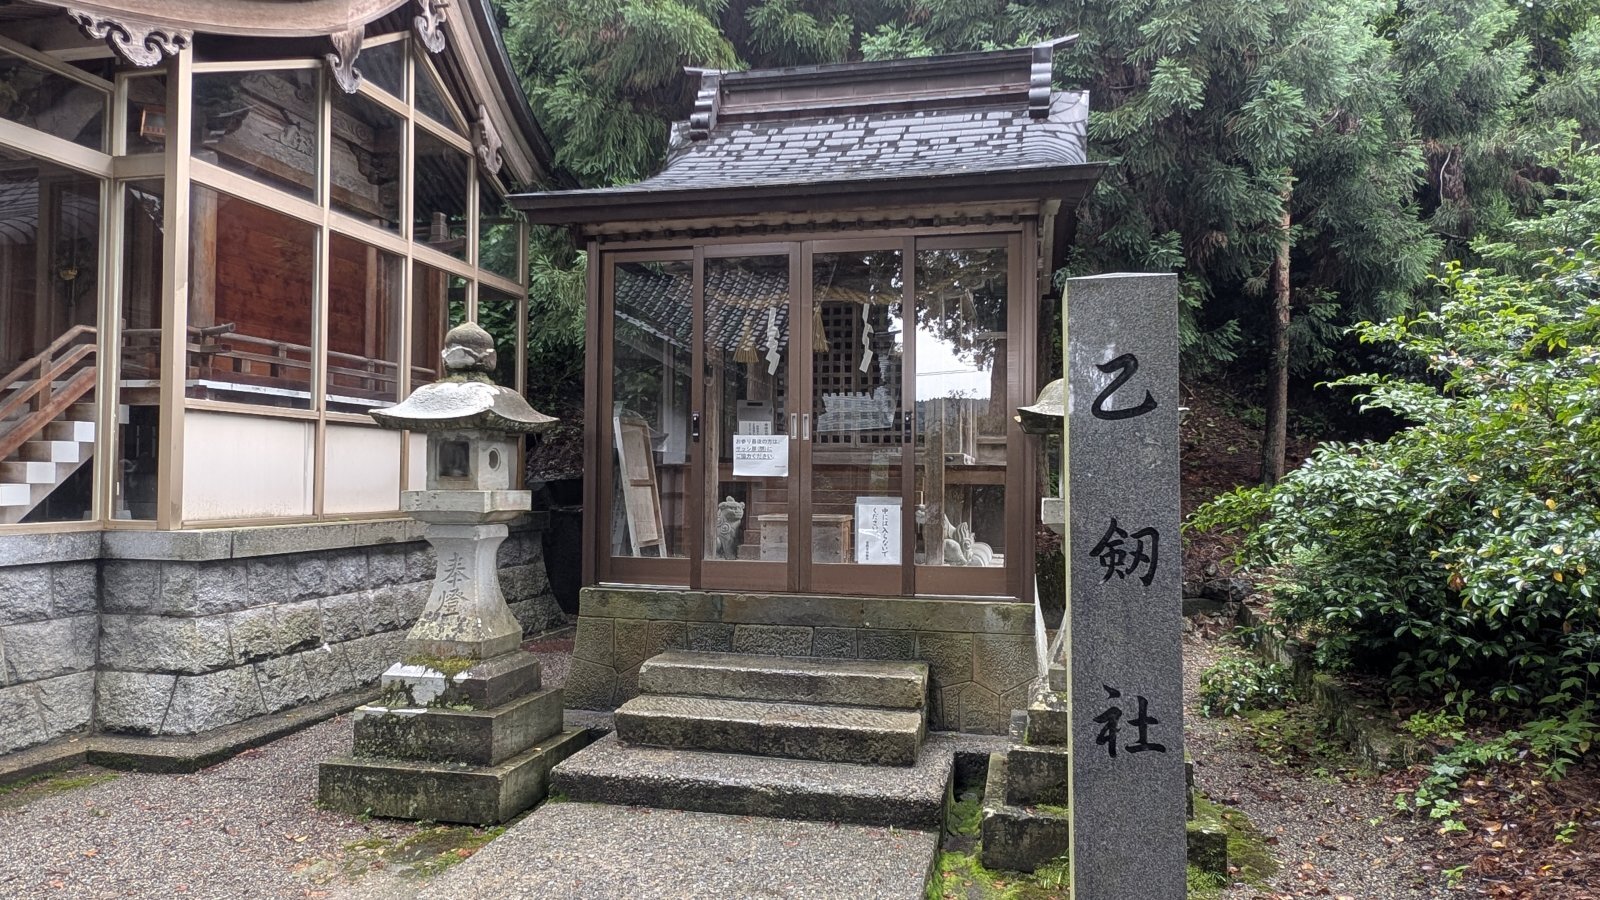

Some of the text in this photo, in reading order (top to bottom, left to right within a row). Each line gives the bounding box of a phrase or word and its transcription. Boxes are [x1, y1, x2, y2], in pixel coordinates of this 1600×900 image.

[881, 507, 889, 557] 中には入らないで
